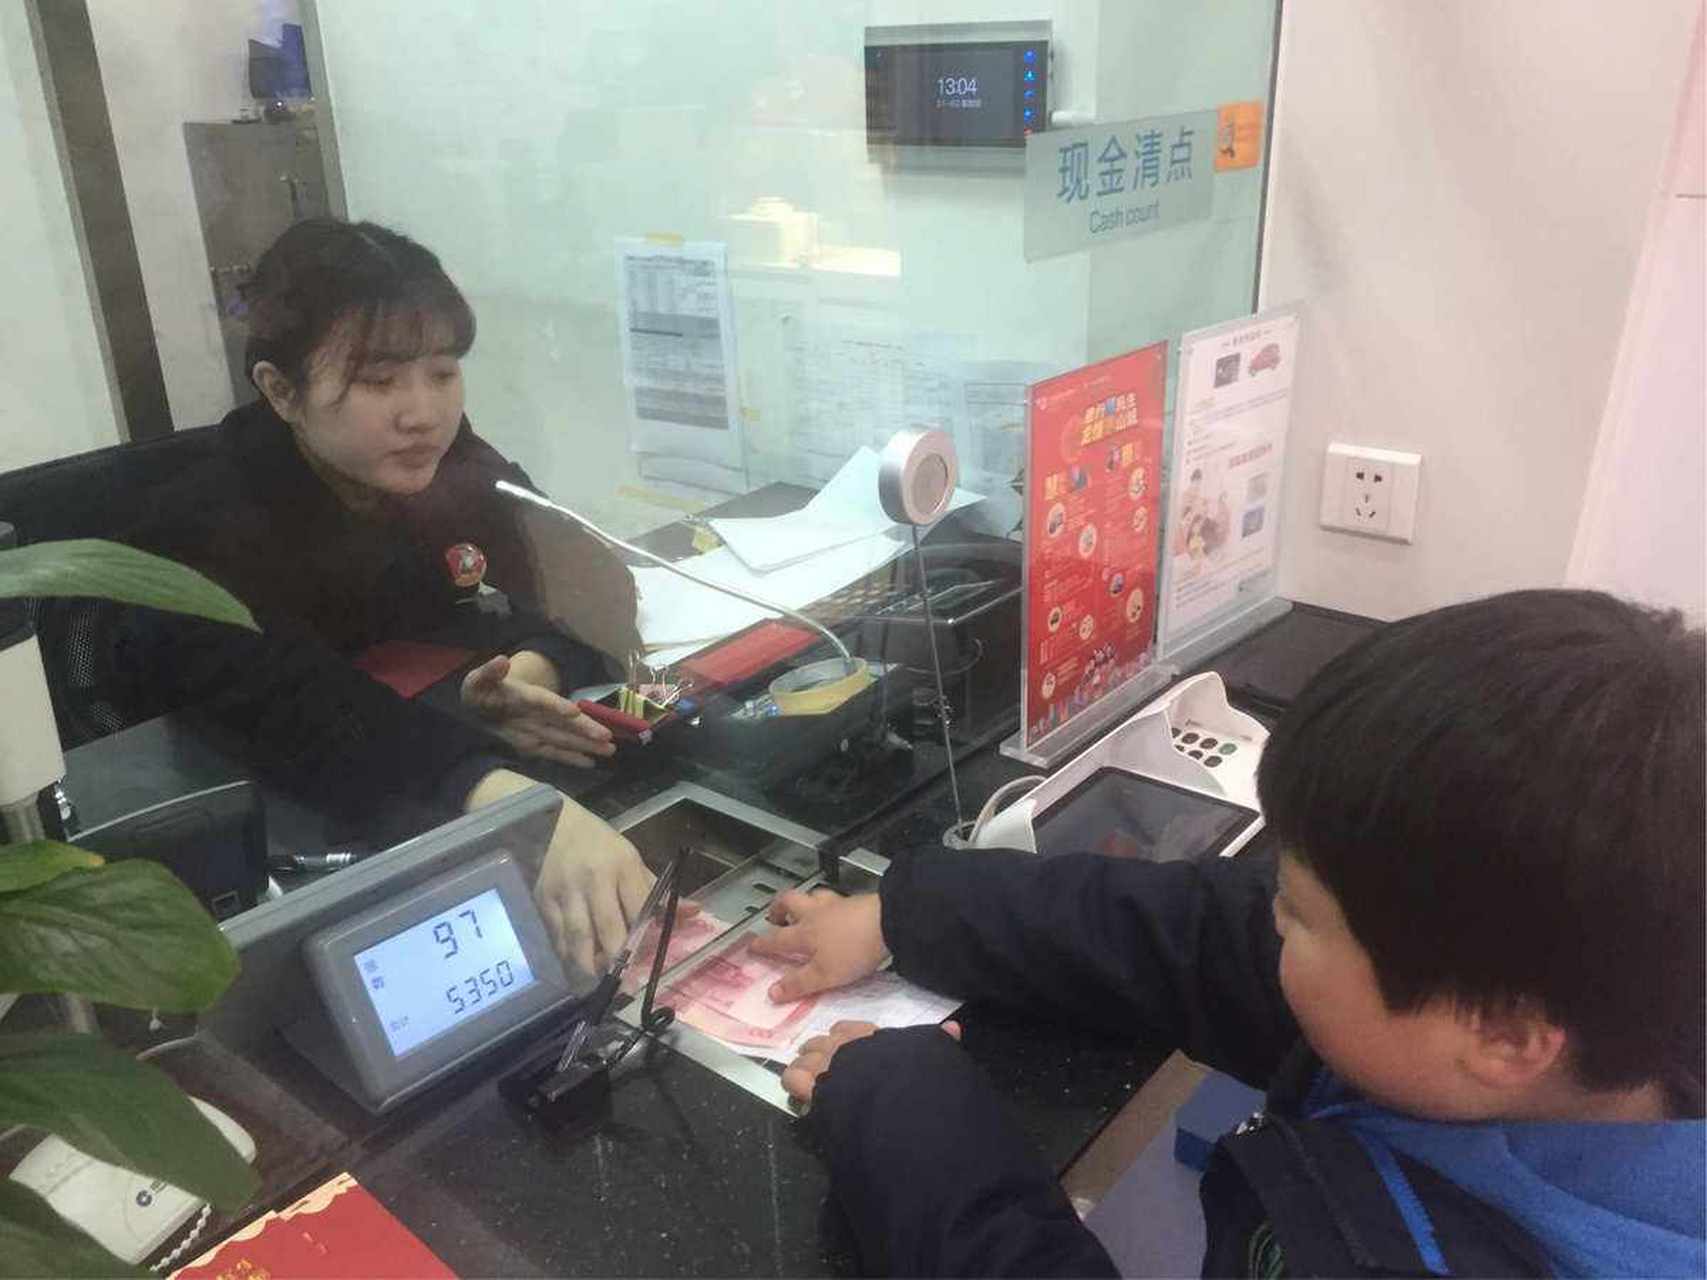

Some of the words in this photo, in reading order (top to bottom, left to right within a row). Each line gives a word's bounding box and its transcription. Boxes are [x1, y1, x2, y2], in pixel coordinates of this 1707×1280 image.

[936, 77, 977, 97] 13:04
[1056, 125, 1195, 204] 现金清点
[1088, 204, 1124, 234] Cash
[1126, 197, 1160, 226] count
[433, 909, 483, 959] 97
[446, 960, 514, 1015] 5350
